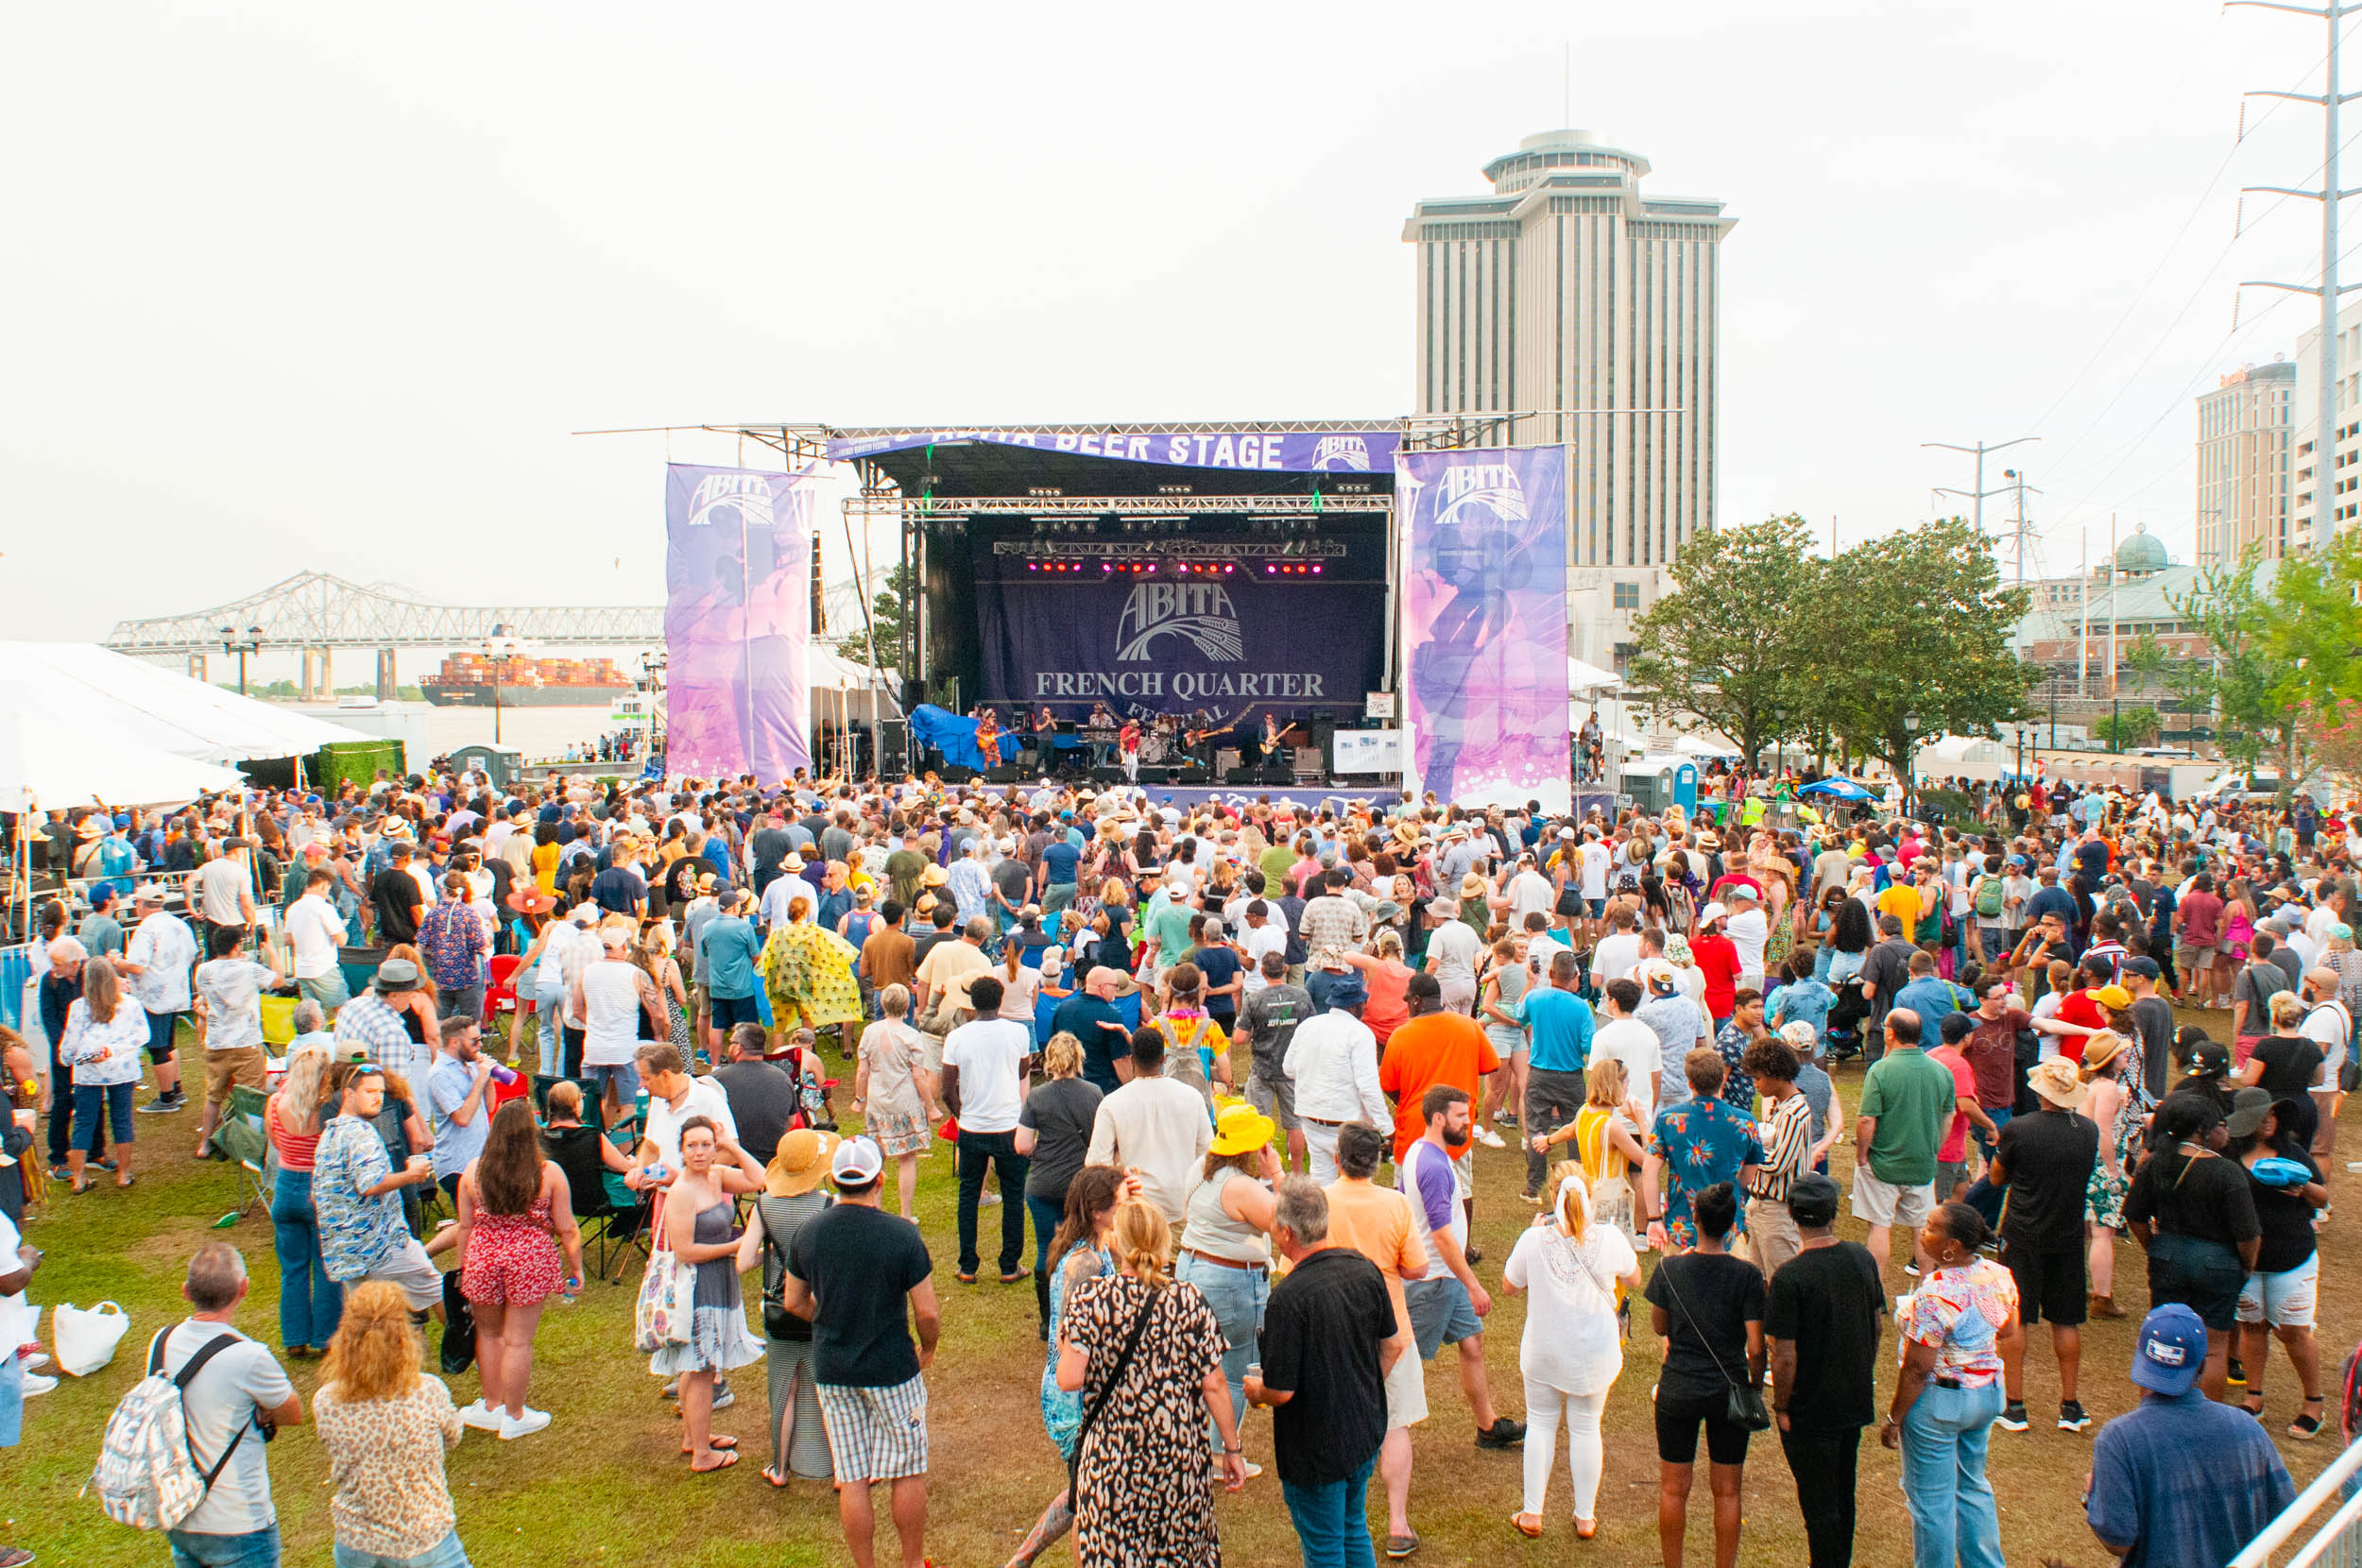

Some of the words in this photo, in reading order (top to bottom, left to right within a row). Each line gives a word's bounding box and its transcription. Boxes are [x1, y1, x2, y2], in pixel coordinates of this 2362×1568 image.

[1055, 434, 1152, 461] BEER
[1169, 435, 1285, 469] STAGE
[1312, 435, 1369, 462] ABITA
[688, 474, 772, 510] ABITA
[1434, 464, 1523, 508] ABITA
[1116, 582, 1237, 644] ABITA
[1036, 672, 1164, 697] FRENCH
[1172, 672, 1325, 702] QUARTER
